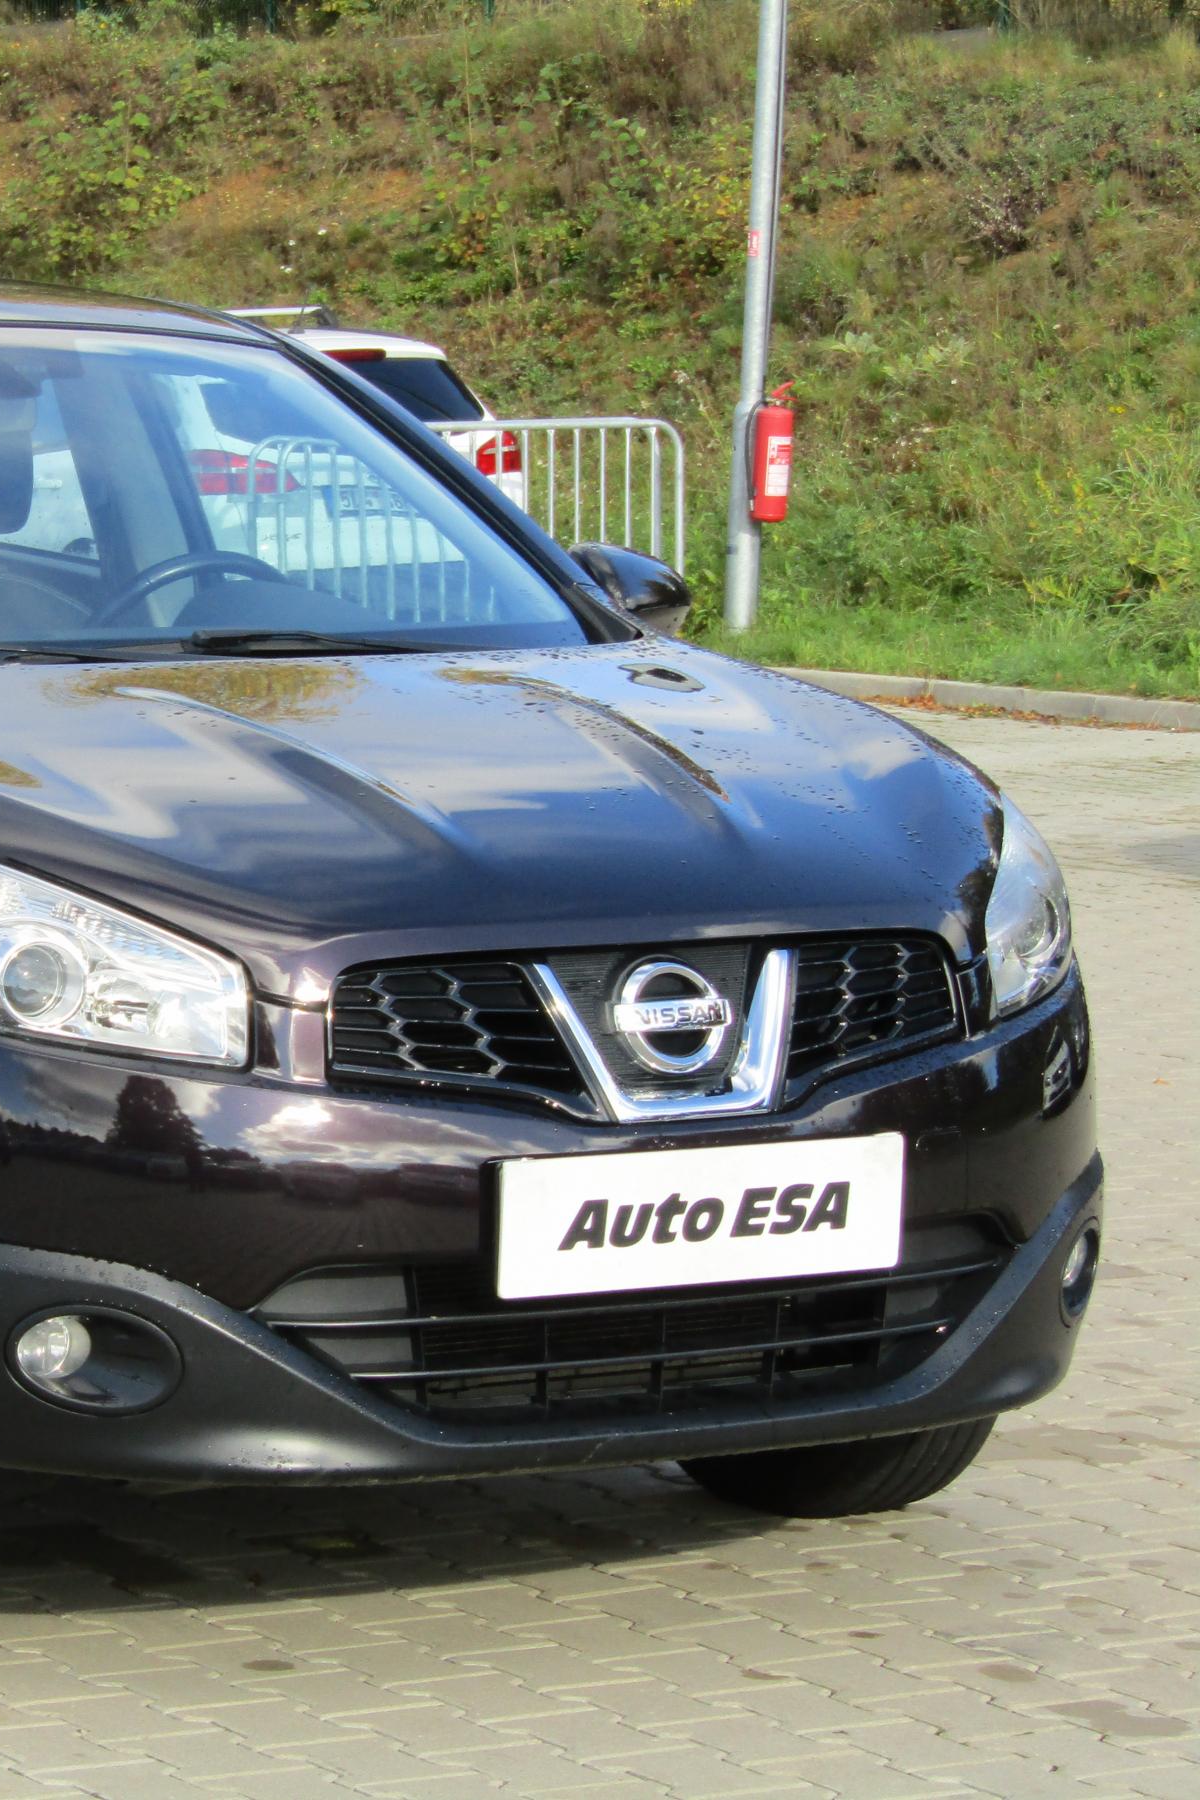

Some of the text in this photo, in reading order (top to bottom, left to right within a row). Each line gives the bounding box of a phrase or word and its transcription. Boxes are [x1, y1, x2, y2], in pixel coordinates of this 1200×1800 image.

[635, 1001, 722, 1025] NISSAN
[557, 1181, 850, 1251] Auto ESA
